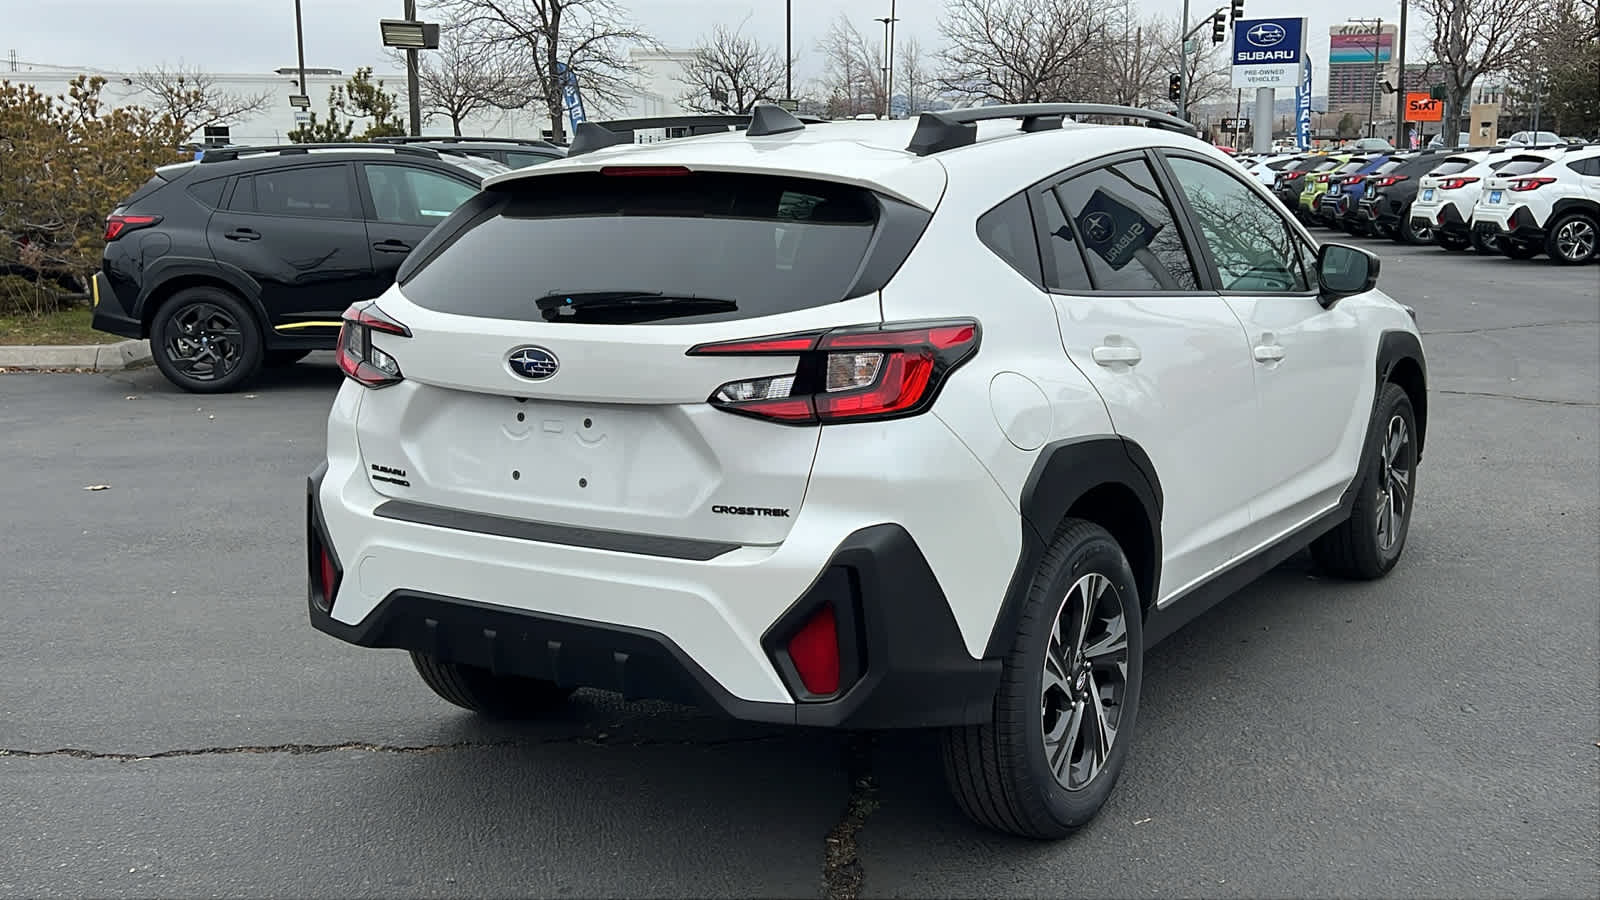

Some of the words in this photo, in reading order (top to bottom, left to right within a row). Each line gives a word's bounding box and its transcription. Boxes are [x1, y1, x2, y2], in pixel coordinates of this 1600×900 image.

[1237, 50, 1294, 61] SUBARU
[1410, 100, 1438, 111] SIXT
[371, 463, 406, 477] SUBARU
[711, 504, 790, 518] CROSSTREK
